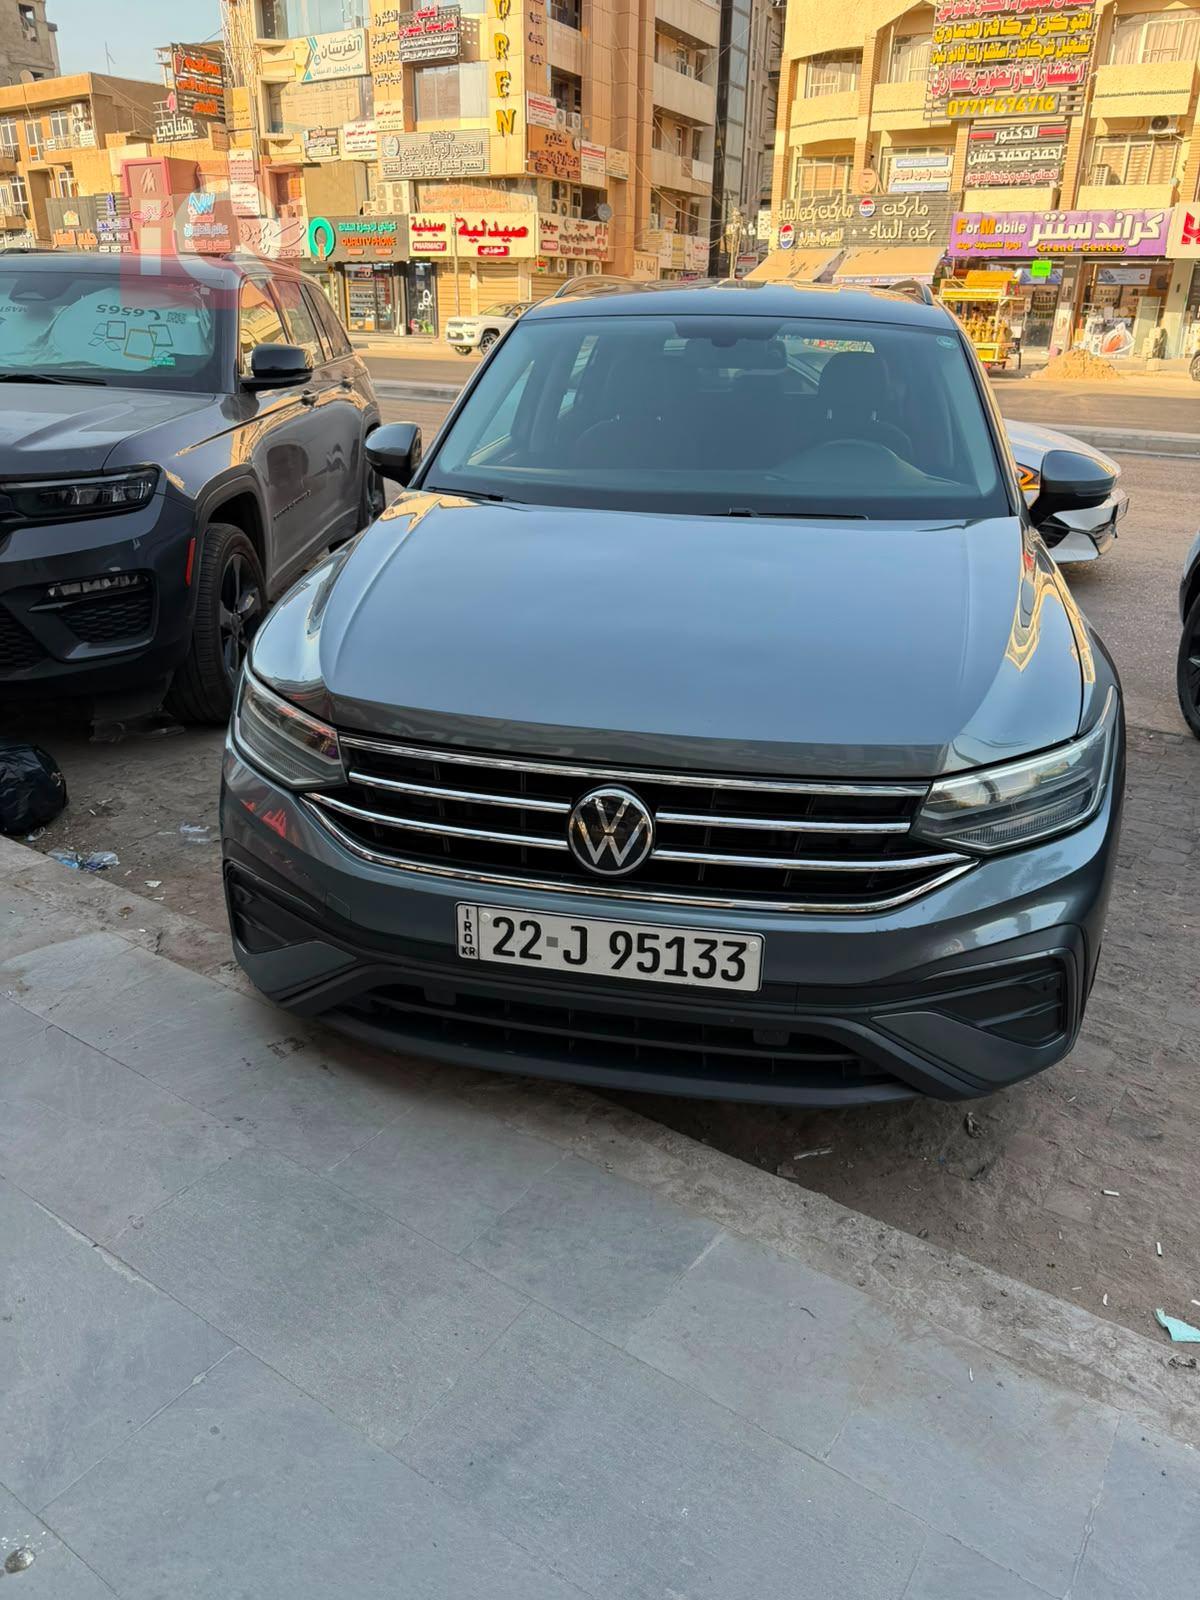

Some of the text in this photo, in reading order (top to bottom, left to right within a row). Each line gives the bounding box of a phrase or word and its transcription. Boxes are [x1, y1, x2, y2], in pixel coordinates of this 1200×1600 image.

[321, 39, 360, 59] الفرسان
[994, 125, 1039, 144] الدكتور
[967, 145, 1062, 166] احمد محمد حسن
[819, 193, 855, 221] ماركت
[882, 195, 929, 218] ماركت
[410, 216, 447, 237] صيدلية
[455, 215, 529, 243] صيدلية
[869, 218, 937, 242] ركن البناء
[1028, 212, 1093, 248] سنتر
[1095, 212, 1164, 247] كراند
[413, 242, 445, 250] PHARMACY
[1038, 242, 1075, 252] Grand
[461, 945, 476, 957] KR
[492, 916, 748, 982] 22 J 95133
